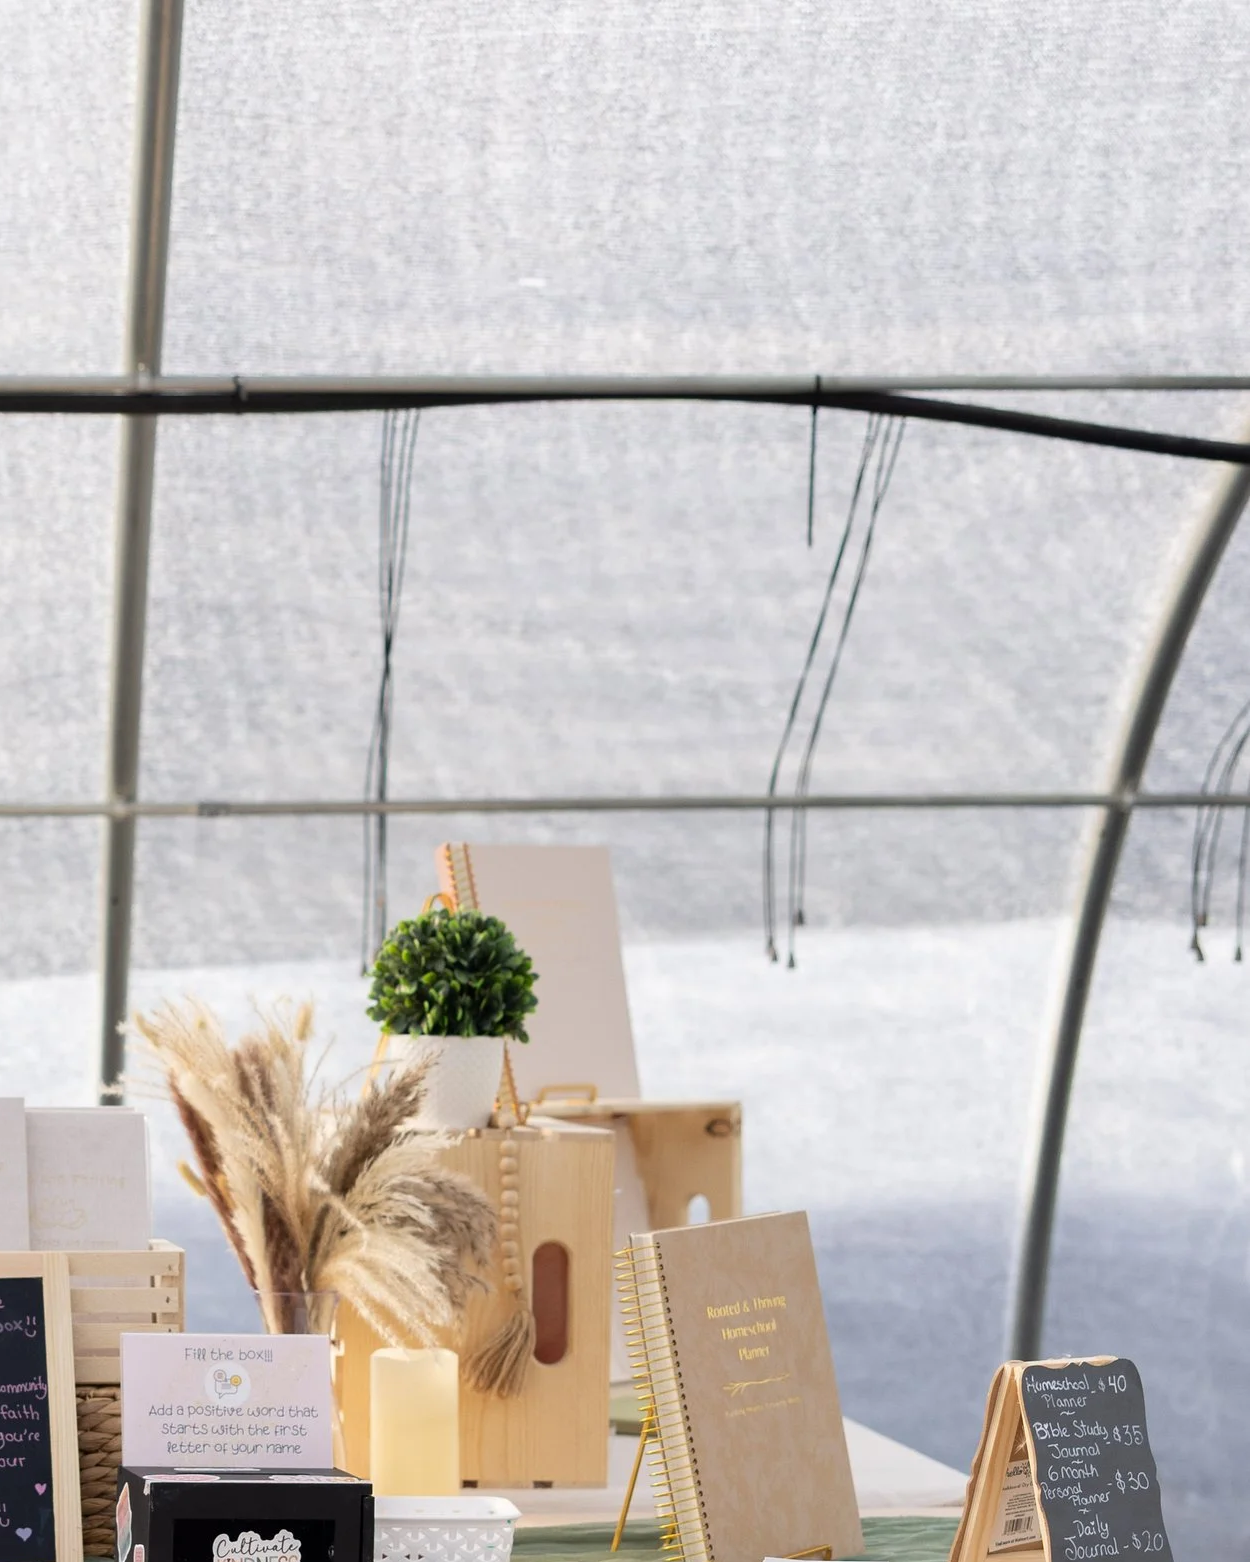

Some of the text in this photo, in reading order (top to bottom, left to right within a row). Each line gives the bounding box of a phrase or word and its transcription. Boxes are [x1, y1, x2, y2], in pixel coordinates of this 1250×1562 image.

[707, 1294, 786, 1319] Rooted & Thriving
[721, 1319, 777, 1341] Homeschool
[184, 1347, 273, 1363] Fill the box!!!
[739, 1347, 770, 1362] Planner
[1025, 1375, 1089, 1392] Homeschool
[1098, 1375, 1126, 1394] $40
[1043, 1394, 1087, 1408] Planner
[0, 1405, 39, 1420] faith
[148, 1404, 318, 1419] Add a positive word that
[161, 1424, 307, 1437] starts with the first
[1033, 1422, 1069, 1440] Bible
[1073, 1420, 1109, 1440] Study
[1113, 1425, 1143, 1446] $35
[166, 1441, 302, 1457] letter of your name
[1050, 1443, 1100, 1459] Journal
[1047, 1468, 1058, 1481] 6
[1058, 1468, 1099, 1481] Month
[1115, 1470, 1149, 1493] $30
[1041, 1483, 1083, 1500] Personal
[1069, 1491, 1110, 1506] Planner
[1073, 1514, 1108, 1539] Daily
[216, 1536, 299, 1556] Cultivate
[1065, 1537, 1119, 1560] Journal
[1132, 1531, 1164, 1552] $20
